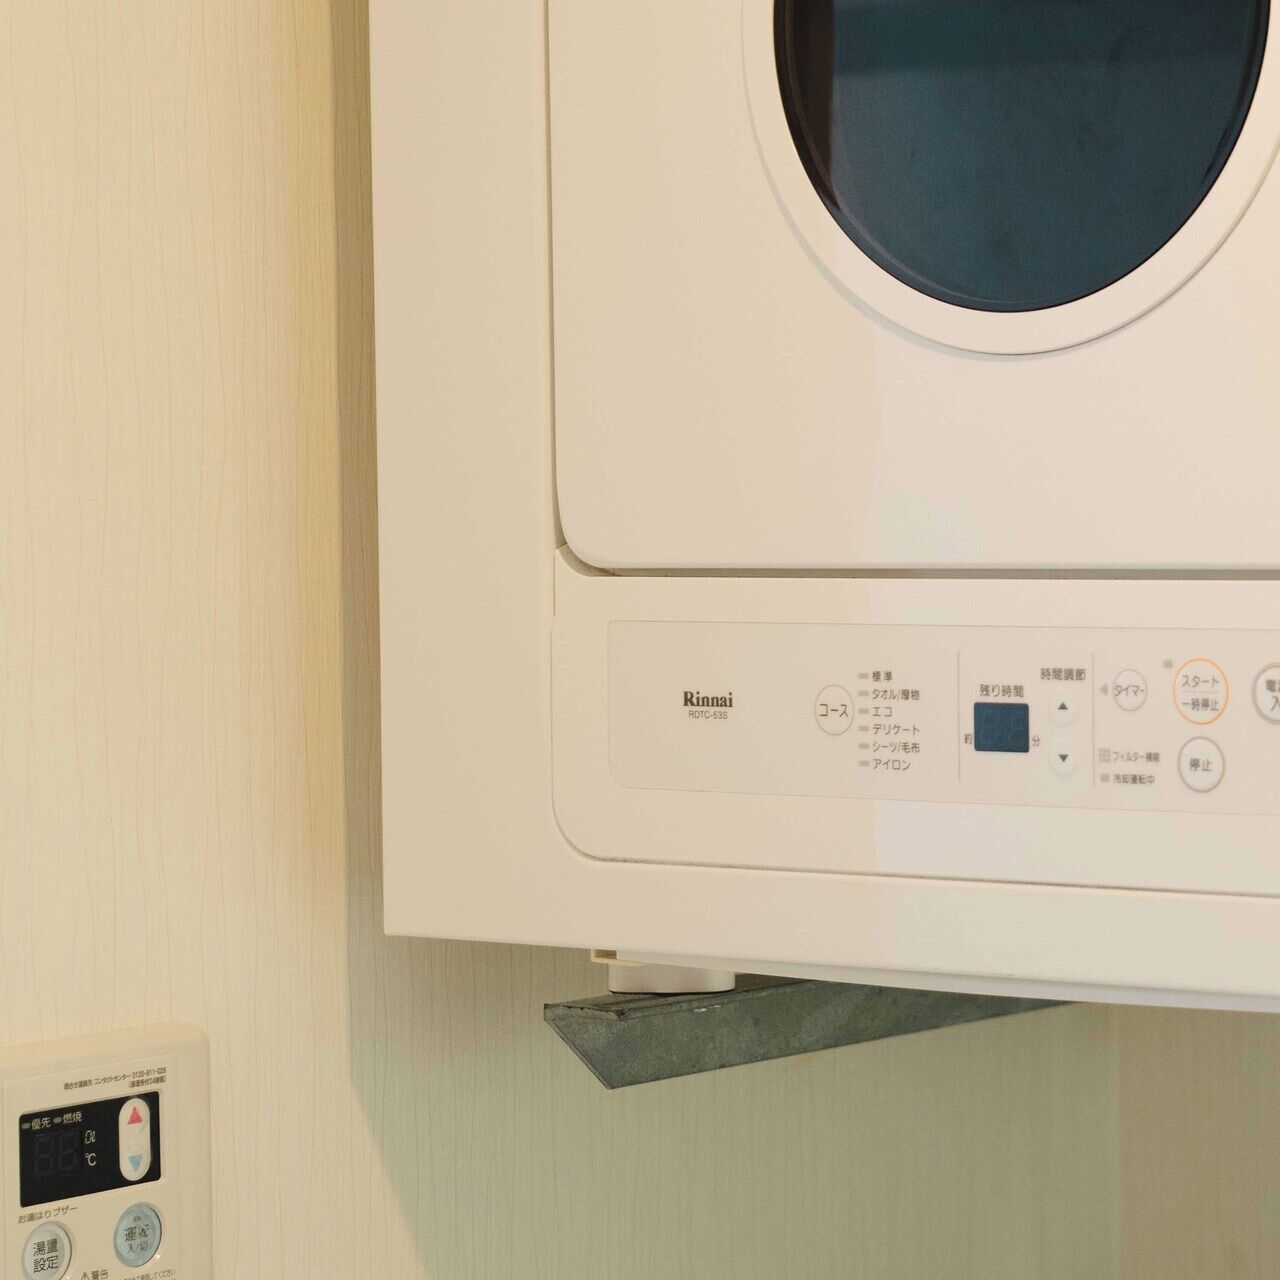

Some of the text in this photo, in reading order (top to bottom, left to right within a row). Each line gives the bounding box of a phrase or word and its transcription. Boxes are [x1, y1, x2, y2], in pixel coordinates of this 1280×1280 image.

[872, 671, 893, 682] 標準
[1040, 668, 1086, 682] 時間調節
[1182, 675, 1221, 688] スタート
[979, 684, 1024, 698] 残り時間
[1114, 685, 1145, 696] タイマー
[683, 691, 734, 708] Rinnai
[1182, 698, 1220, 712] 一時停止
[688, 709, 728, 720] RDTC-53S
[819, 703, 849, 719] コース
[872, 706, 893, 717] エコ
[872, 723, 920, 736] デリケート
[872, 741, 920, 754] シーツ/毛布
[1032, 736, 1041, 747] 分
[872, 759, 911, 771] アイロン
[1189, 758, 1213, 772] 停止
[1113, 773, 1155, 785] 冷却運転中
[30, 1109, 83, 1130] 優先 燃焼
[32, 1237, 59, 1258] 湯量
[33, 1255, 59, 1273] 設定
[91, 1269, 108, 1280] 警告
